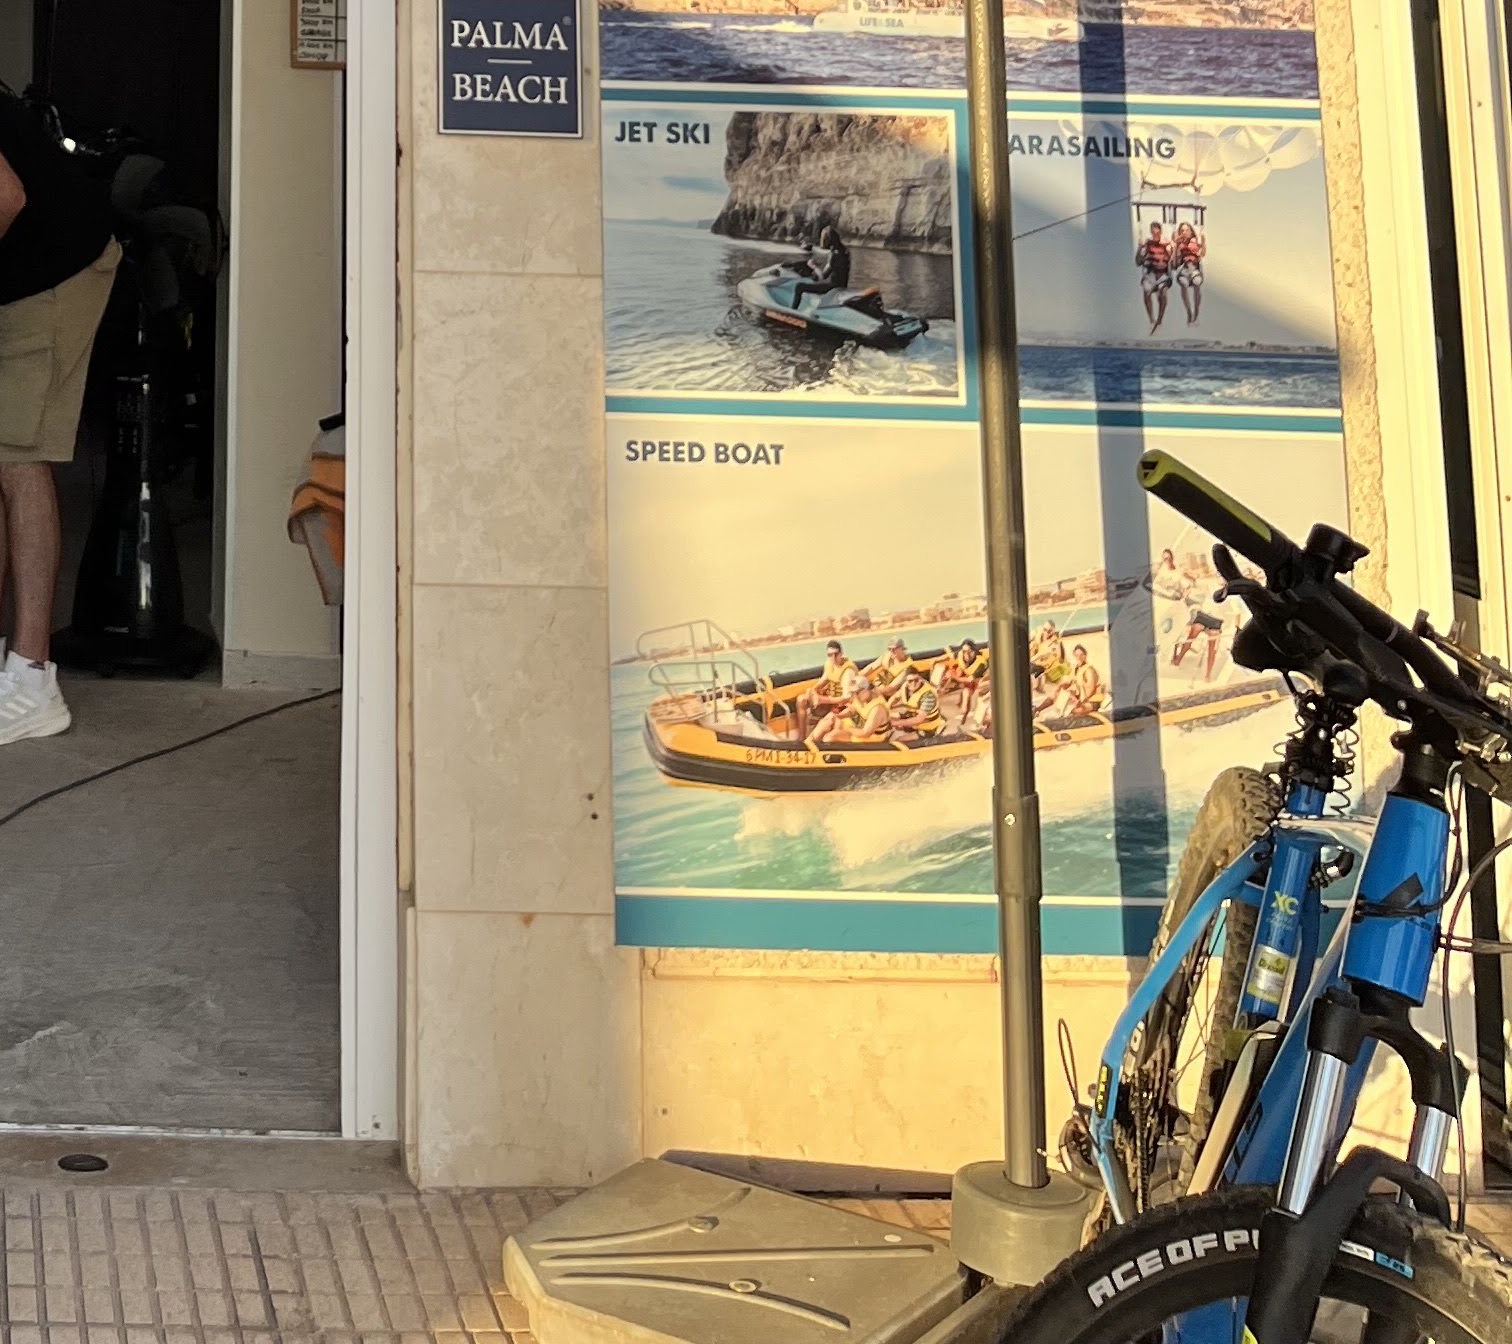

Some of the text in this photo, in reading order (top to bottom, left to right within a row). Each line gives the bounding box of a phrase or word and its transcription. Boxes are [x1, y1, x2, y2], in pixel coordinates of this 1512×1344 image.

[450, 19, 569, 51] PALMA
[451, 73, 569, 105] BEACH
[614, 120, 710, 145] JET SKI
[1007, 134, 1176, 160] ARASAILING
[625, 439, 785, 466] SPEED BOAT
[1271, 891, 1298, 916] XC
